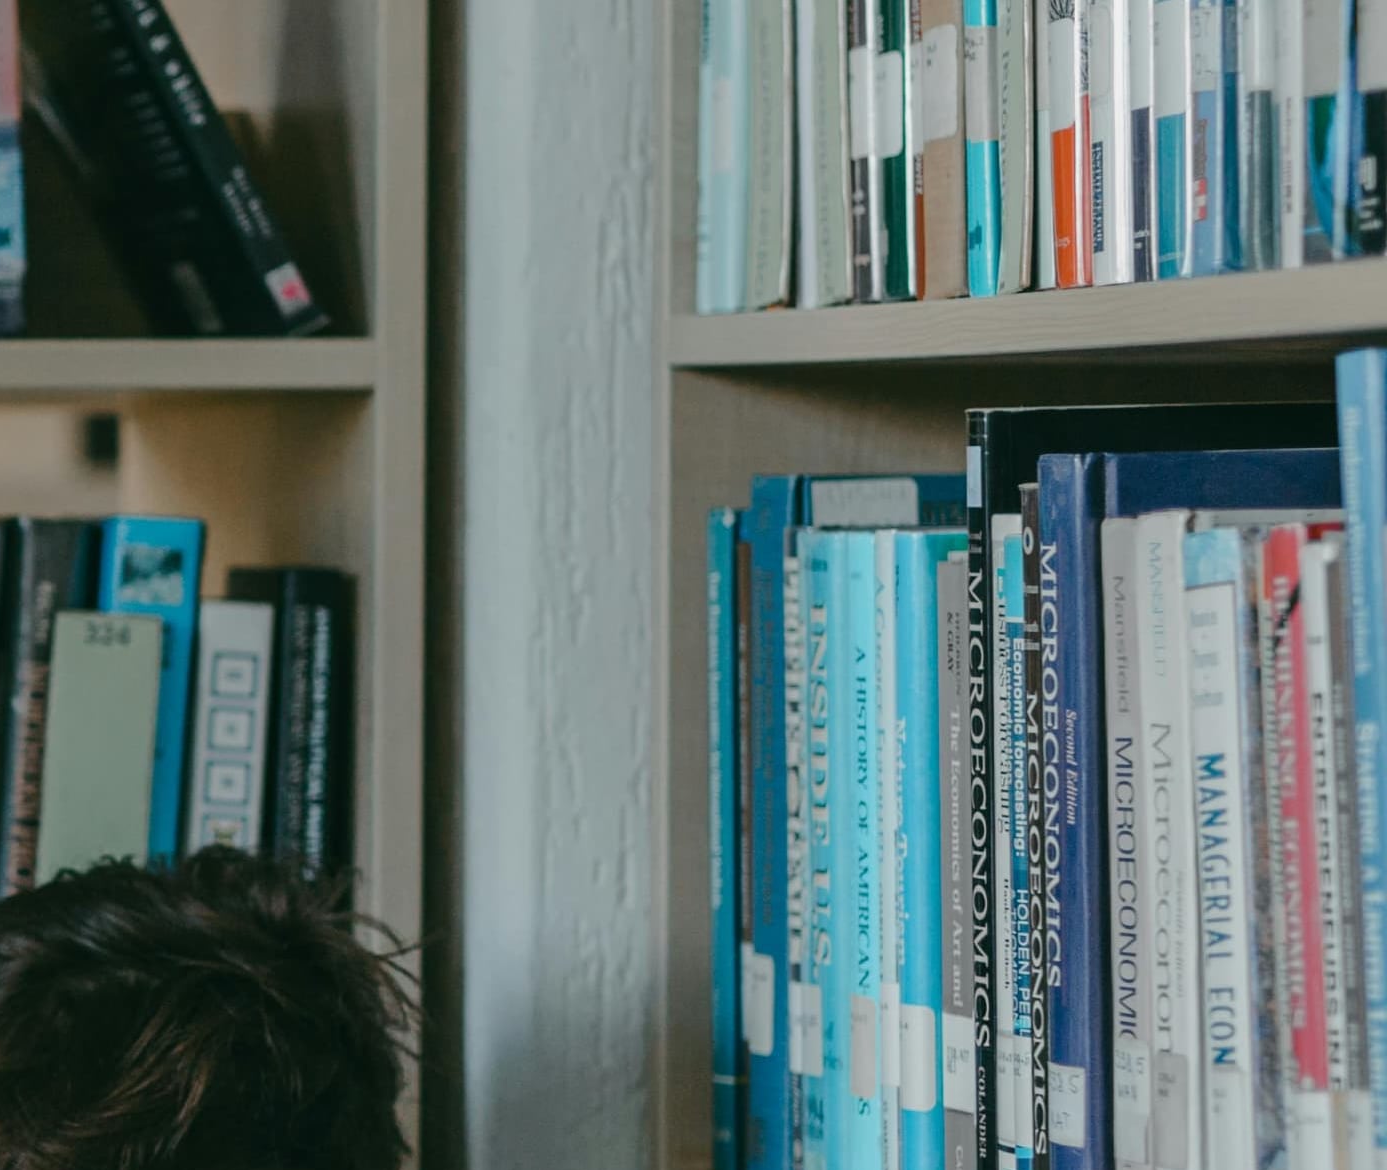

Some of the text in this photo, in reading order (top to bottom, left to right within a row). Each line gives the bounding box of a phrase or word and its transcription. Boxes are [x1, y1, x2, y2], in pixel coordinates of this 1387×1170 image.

[809, 605, 832, 979] INSIDE U.S.
[854, 646, 871, 990] A HISTORY OF AMERICAN
[894, 716, 908, 827] Nature
[950, 705, 964, 1008] The Economics of Art and
[968, 568, 990, 1048] MICROECONOMICS
[1012, 636, 1028, 858] Economic forecasting:
[1040, 541, 1062, 988] MICROECONOMICS
[1066, 709, 1078, 825] Second Edition
[1112, 574, 1138, 1040] Mansfield MICROECONOMIC
[1195, 752, 1234, 959] MANAGERIAL
[1016, 888, 1030, 980] HOLDEN,
[1026, 690, 1047, 1156] MICROECONOMICS
[978, 1065, 987, 1159] COLANDER
